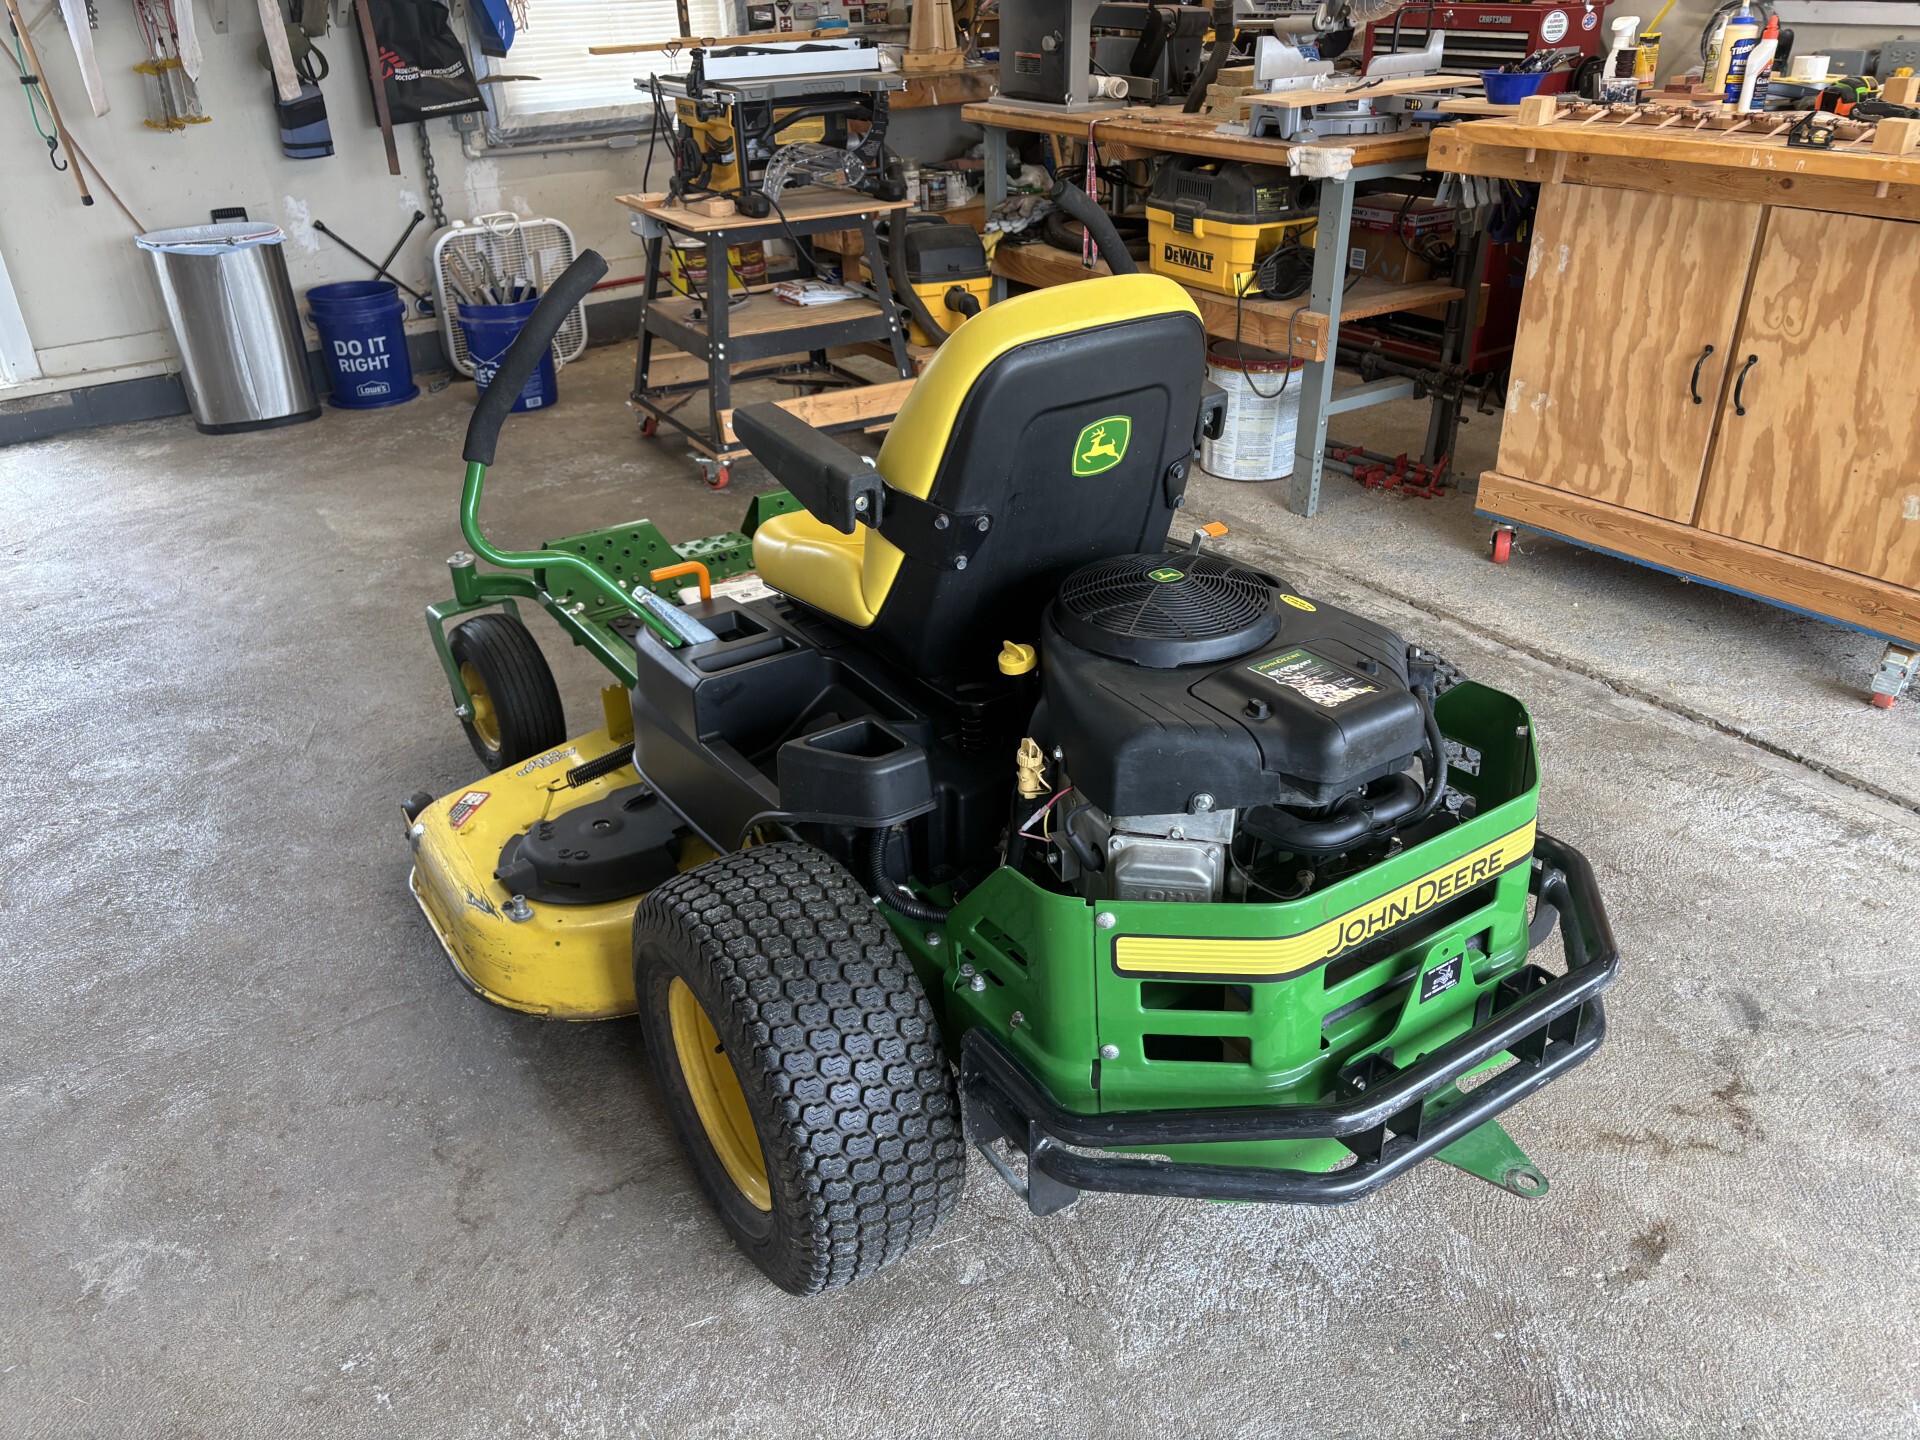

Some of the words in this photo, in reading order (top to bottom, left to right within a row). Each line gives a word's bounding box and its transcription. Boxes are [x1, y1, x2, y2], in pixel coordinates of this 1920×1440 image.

[1479, 15, 1512, 24] CRAFTSMAN
[334, 339, 363, 357] DO
[368, 336, 386, 354] IT
[338, 354, 391, 373] RIGHT
[359, 383, 388, 395] LOWE'S
[1327, 896, 1408, 955] JOHN
[1415, 848, 1504, 911] DEERE
